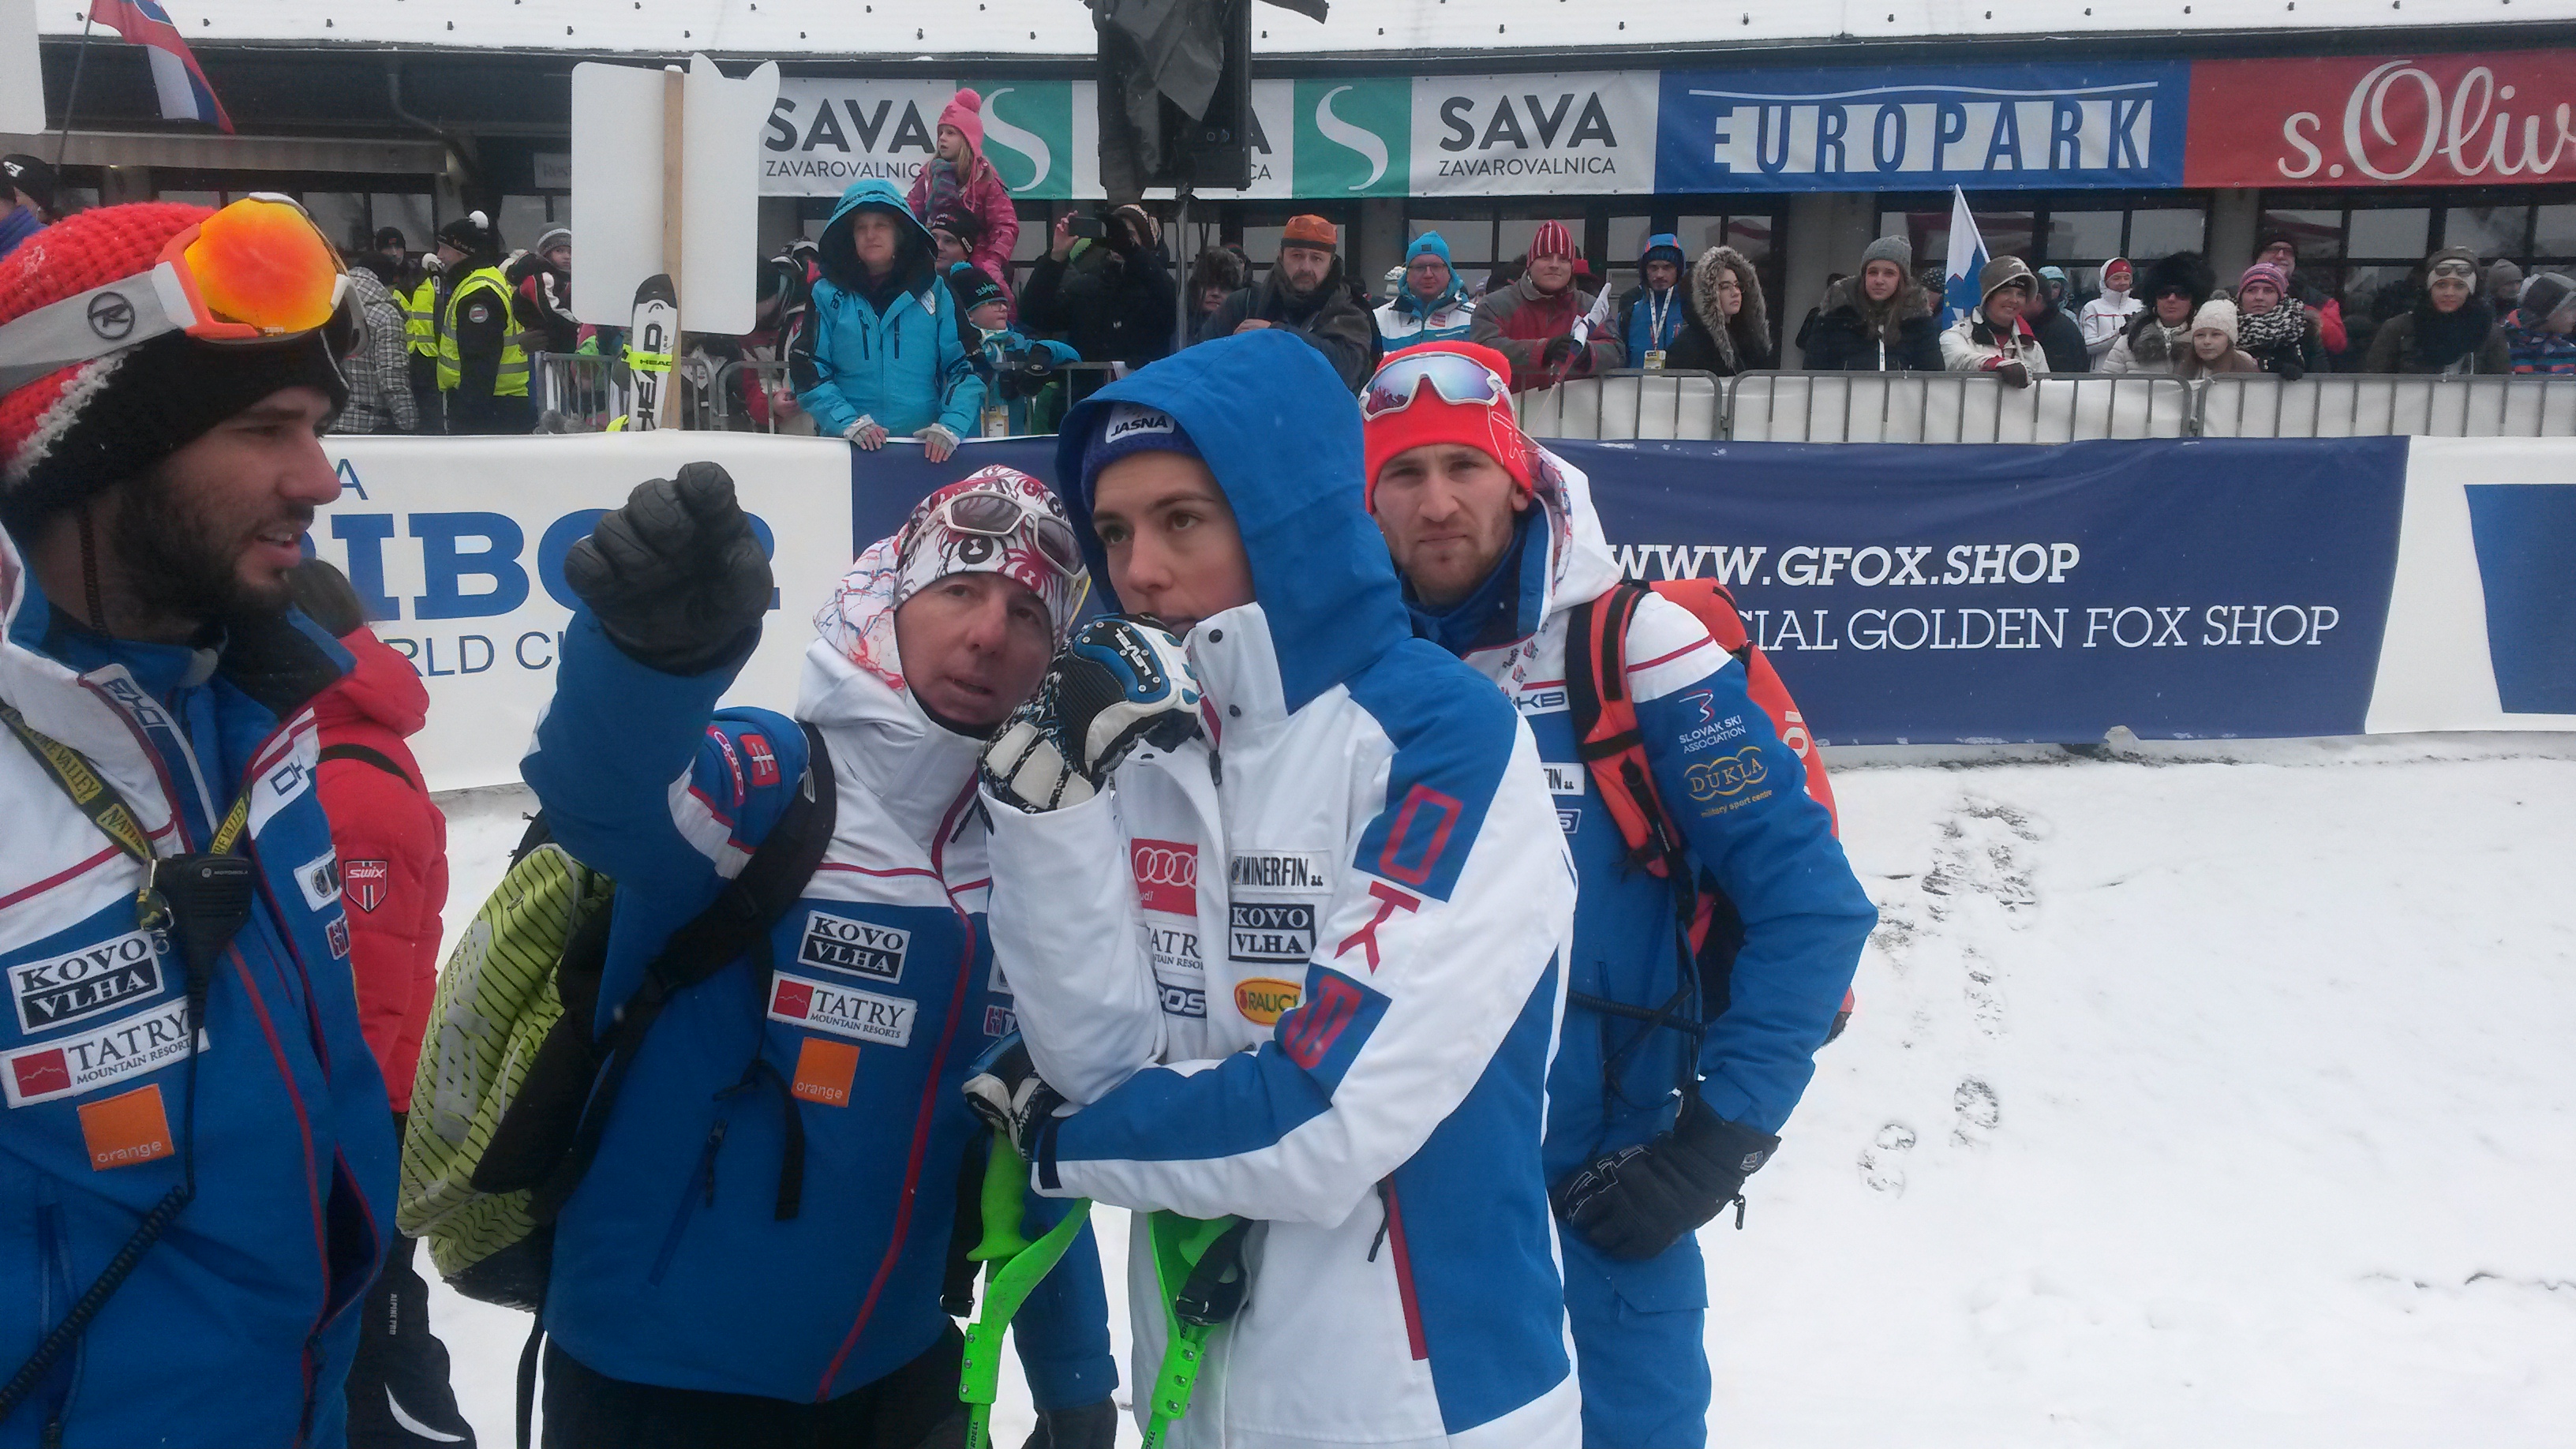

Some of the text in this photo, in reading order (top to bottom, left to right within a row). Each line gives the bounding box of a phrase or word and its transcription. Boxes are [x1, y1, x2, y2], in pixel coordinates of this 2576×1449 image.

[765, 97, 935, 153] SAVA
[1439, 92, 1618, 152] SAVA
[1714, 99, 2152, 174] EUROPARK
[1438, 157, 1616, 178] ZAVAROVALNICA
[1111, 415, 1168, 437] JASNA
[1607, 542, 2080, 586] WWW.GFOX.SHOP
[1739, 605, 2339, 650] IAL GOLDEN FOX SHOP
[515, 631, 565, 670] C
[1114, 627, 1152, 676] LEVEL
[1513, 691, 1566, 711] KB
[1679, 714, 1742, 744] SLOVAK SKI
[1683, 725, 1747, 754] ASSOCIATION
[1690, 757, 1764, 792] DUKLA
[1729, 797, 1751, 811] sport
[1752, 789, 1773, 803] centre
[1241, 856, 1309, 887] MINERFIN
[811, 915, 904, 950] KOVO
[1232, 907, 1309, 928] KOVO
[812, 939, 893, 974] VLHA
[1234, 933, 1306, 955] VLHA
[17, 937, 148, 994] KOVO
[32, 969, 150, 1019] VLHA
[815, 989, 907, 1029] TATRY
[68, 1005, 191, 1072] TATRY
[810, 1013, 901, 1039] MOUNTAIN RESORTS
[76, 1054, 148, 1085] MOUNTAIN
[796, 1080, 844, 1100] orange
[97, 1140, 163, 1163] orange
